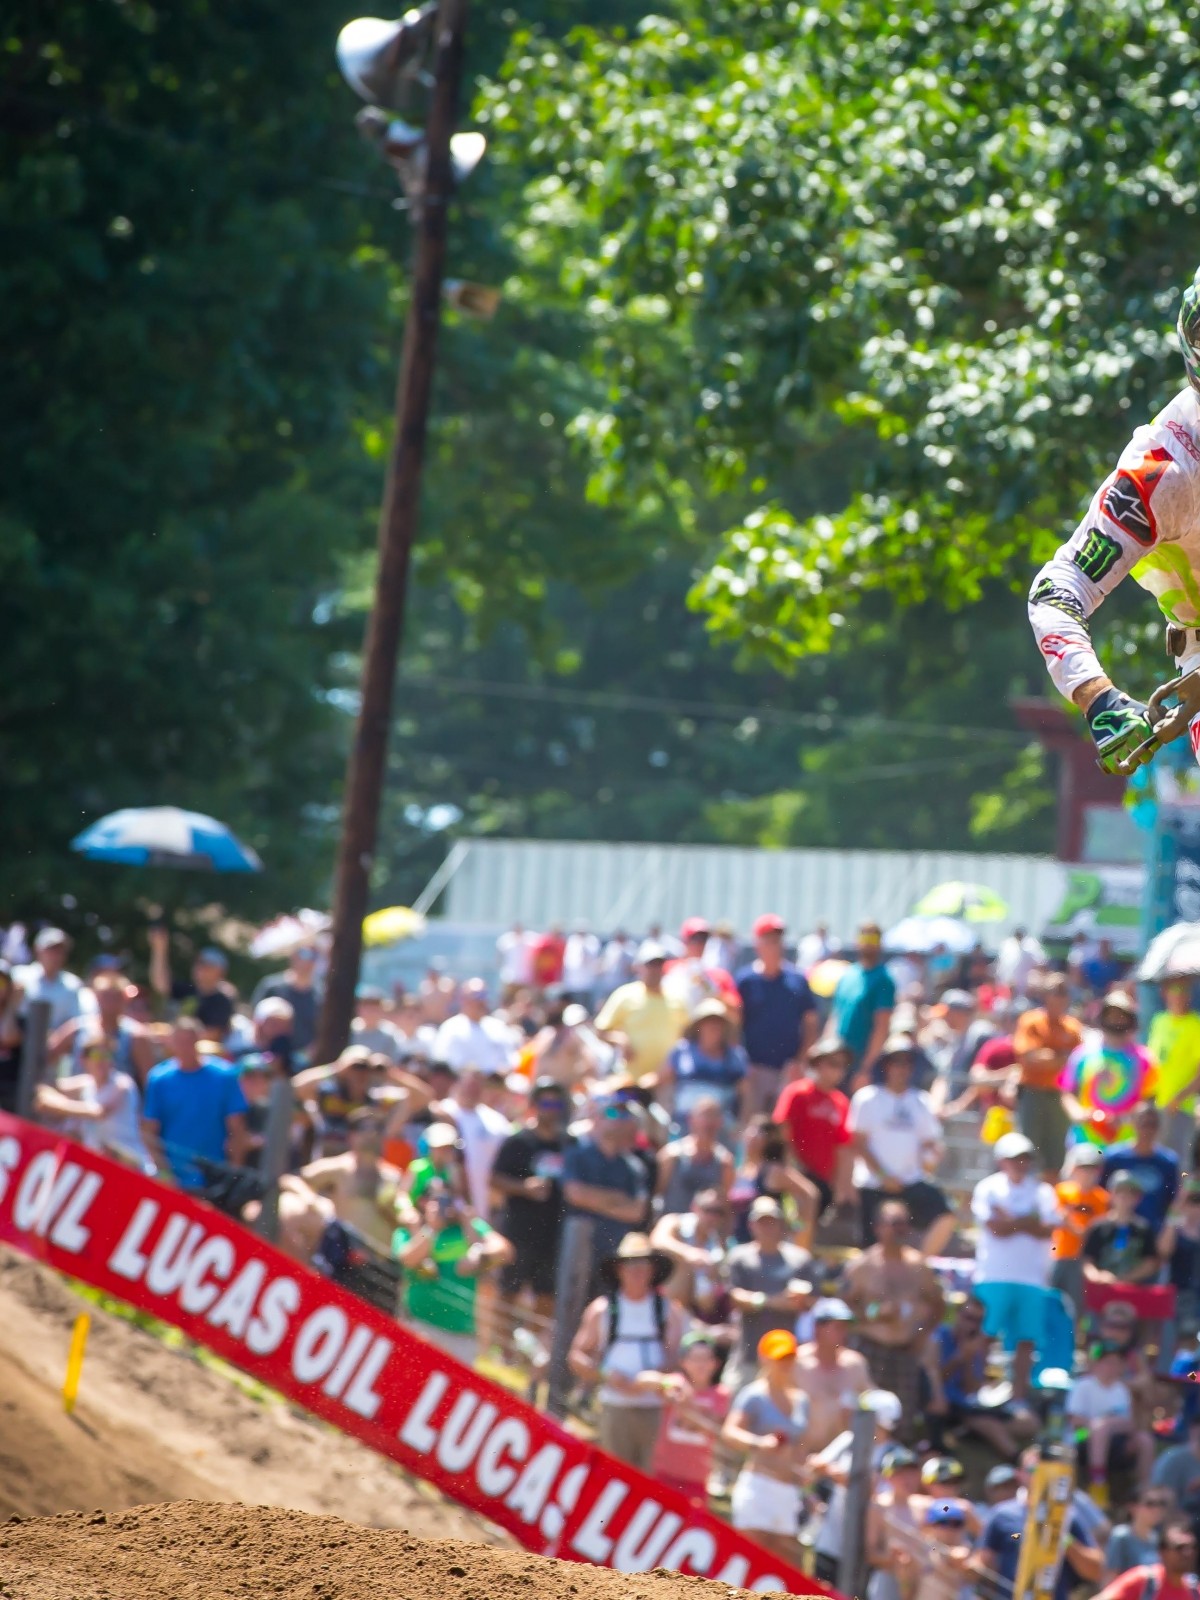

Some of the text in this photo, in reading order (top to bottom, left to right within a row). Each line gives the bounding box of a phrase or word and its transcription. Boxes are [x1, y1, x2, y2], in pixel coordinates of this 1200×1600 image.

[13, 1150, 104, 1254] OIL
[107, 1197, 301, 1353] LUCAS
[291, 1303, 393, 1418] OIL
[571, 1477, 787, 1592] LUC
